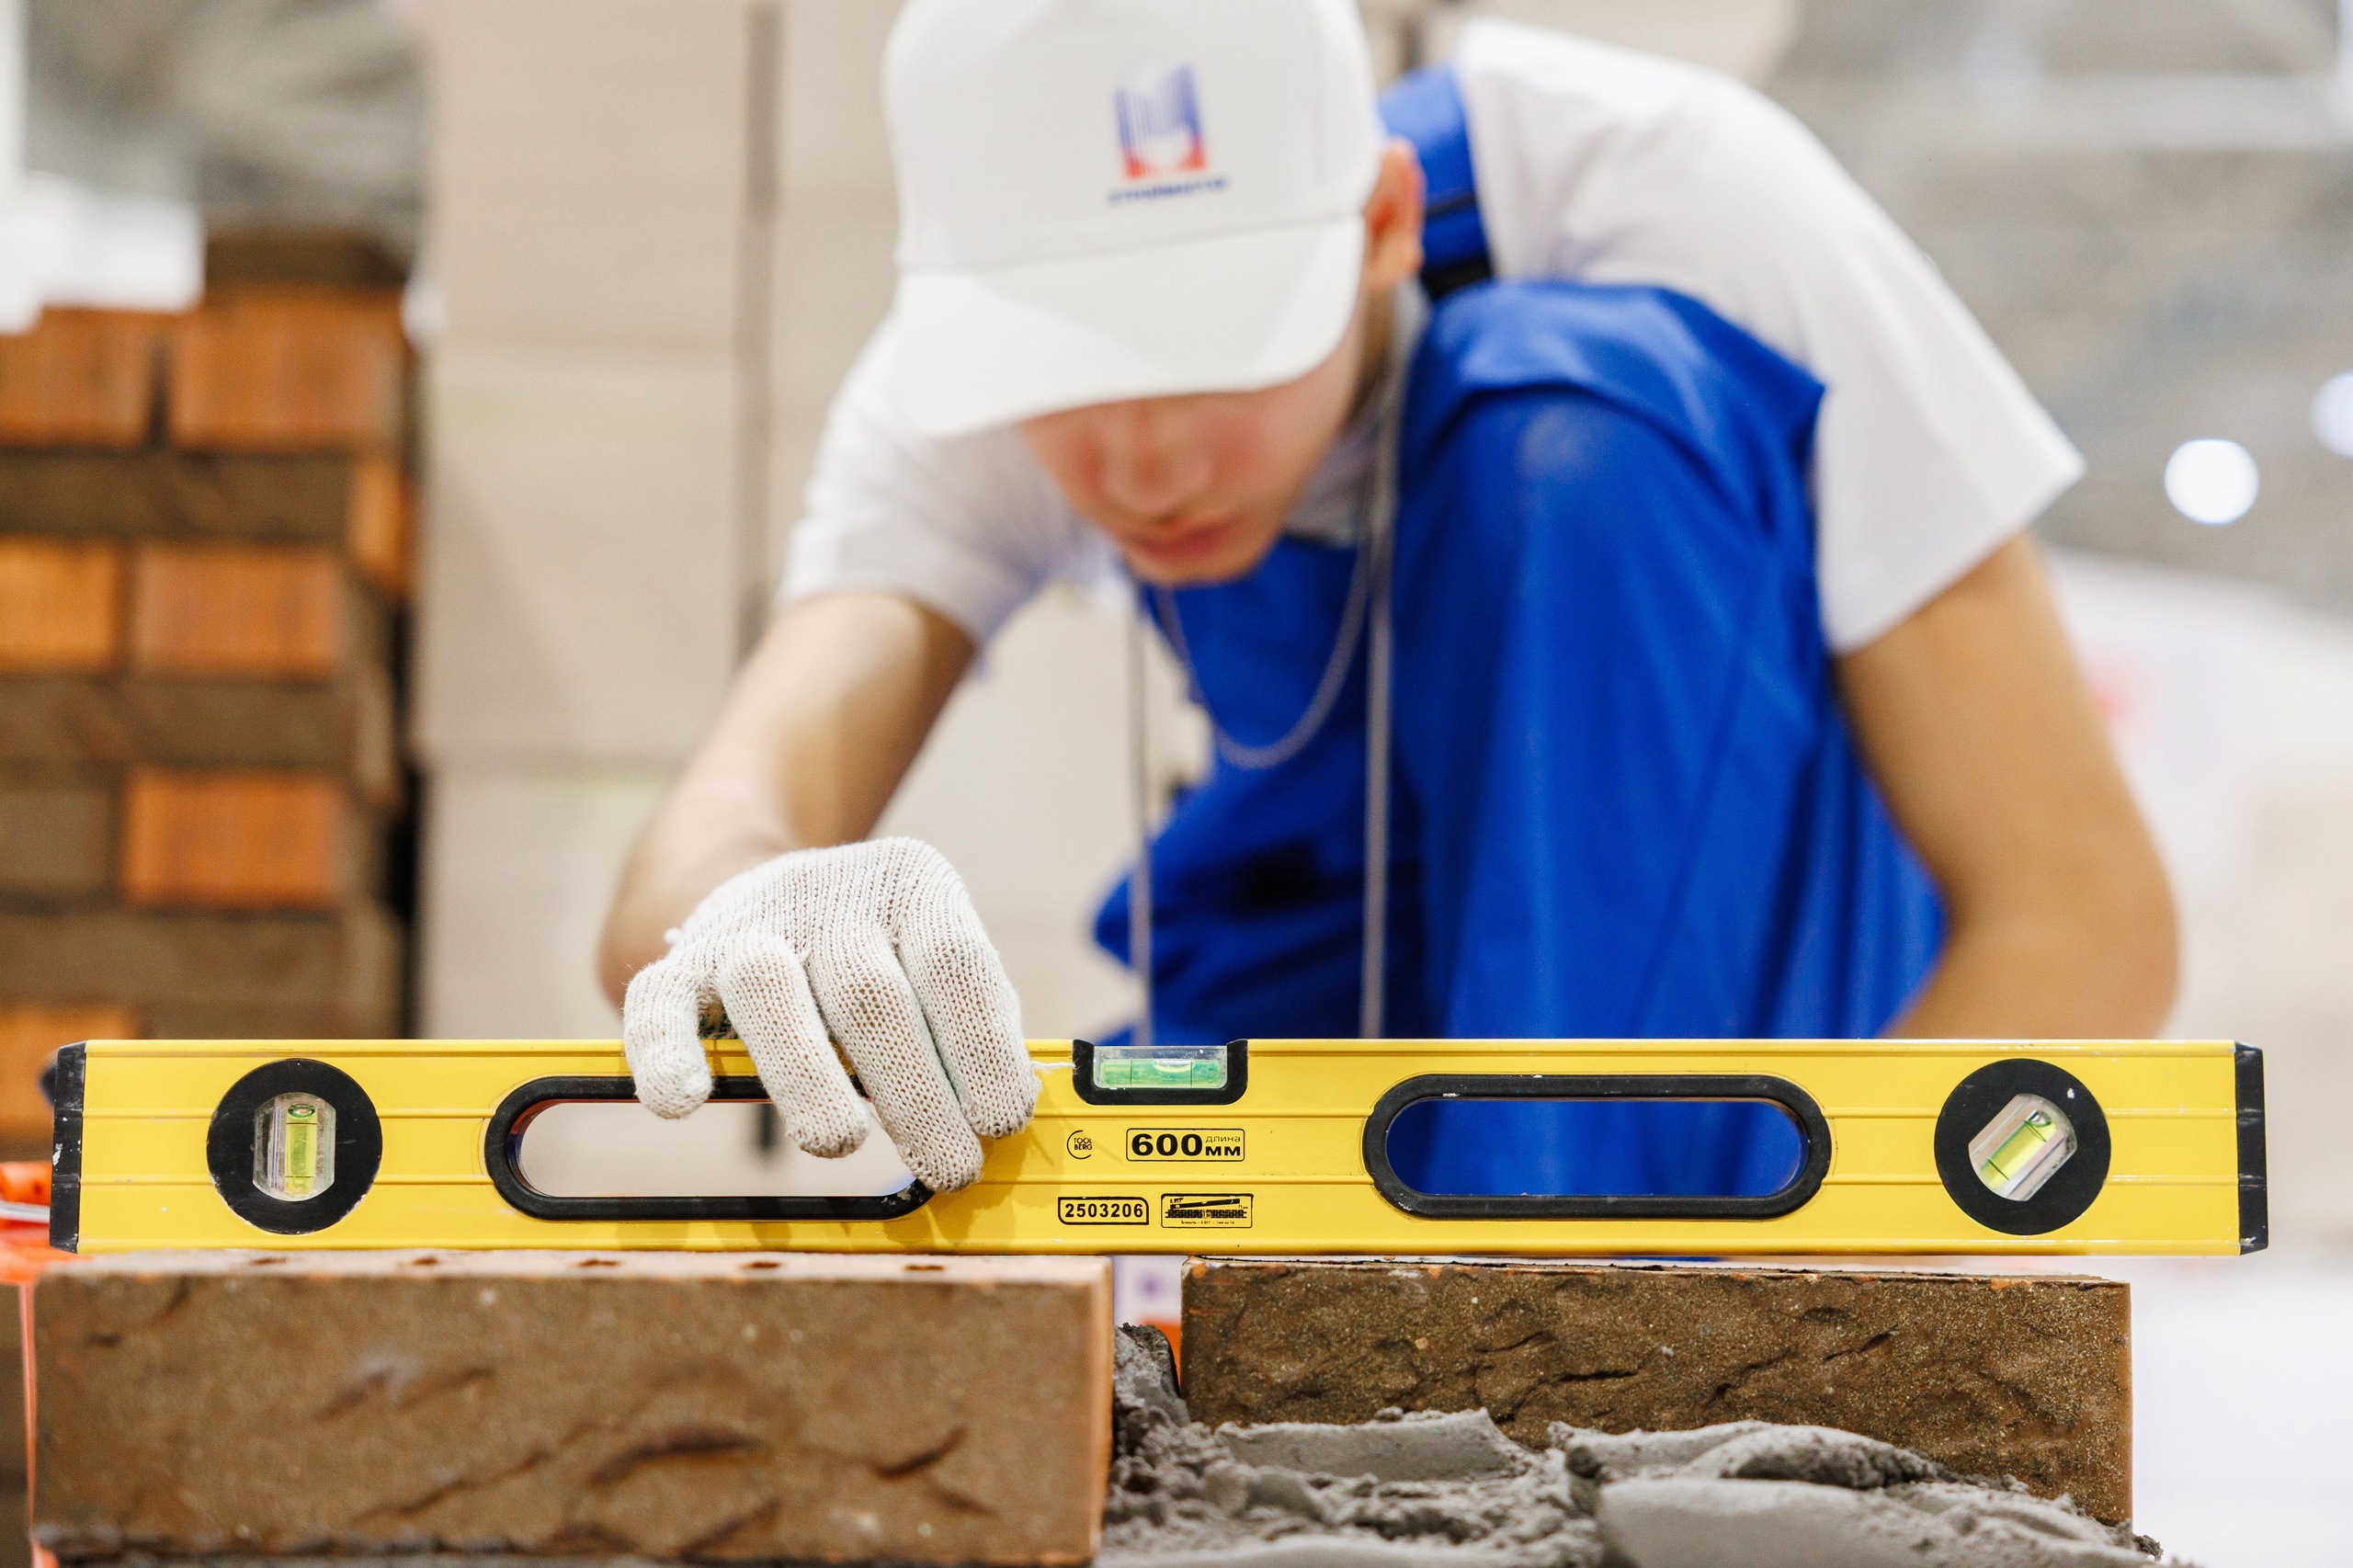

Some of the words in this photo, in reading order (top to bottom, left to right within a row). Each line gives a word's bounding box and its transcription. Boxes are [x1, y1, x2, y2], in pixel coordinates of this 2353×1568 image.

[1131, 1132, 1203, 1156] 600
[1205, 1135, 1241, 1143] длина
[1064, 1202, 1143, 1218] 2503206
